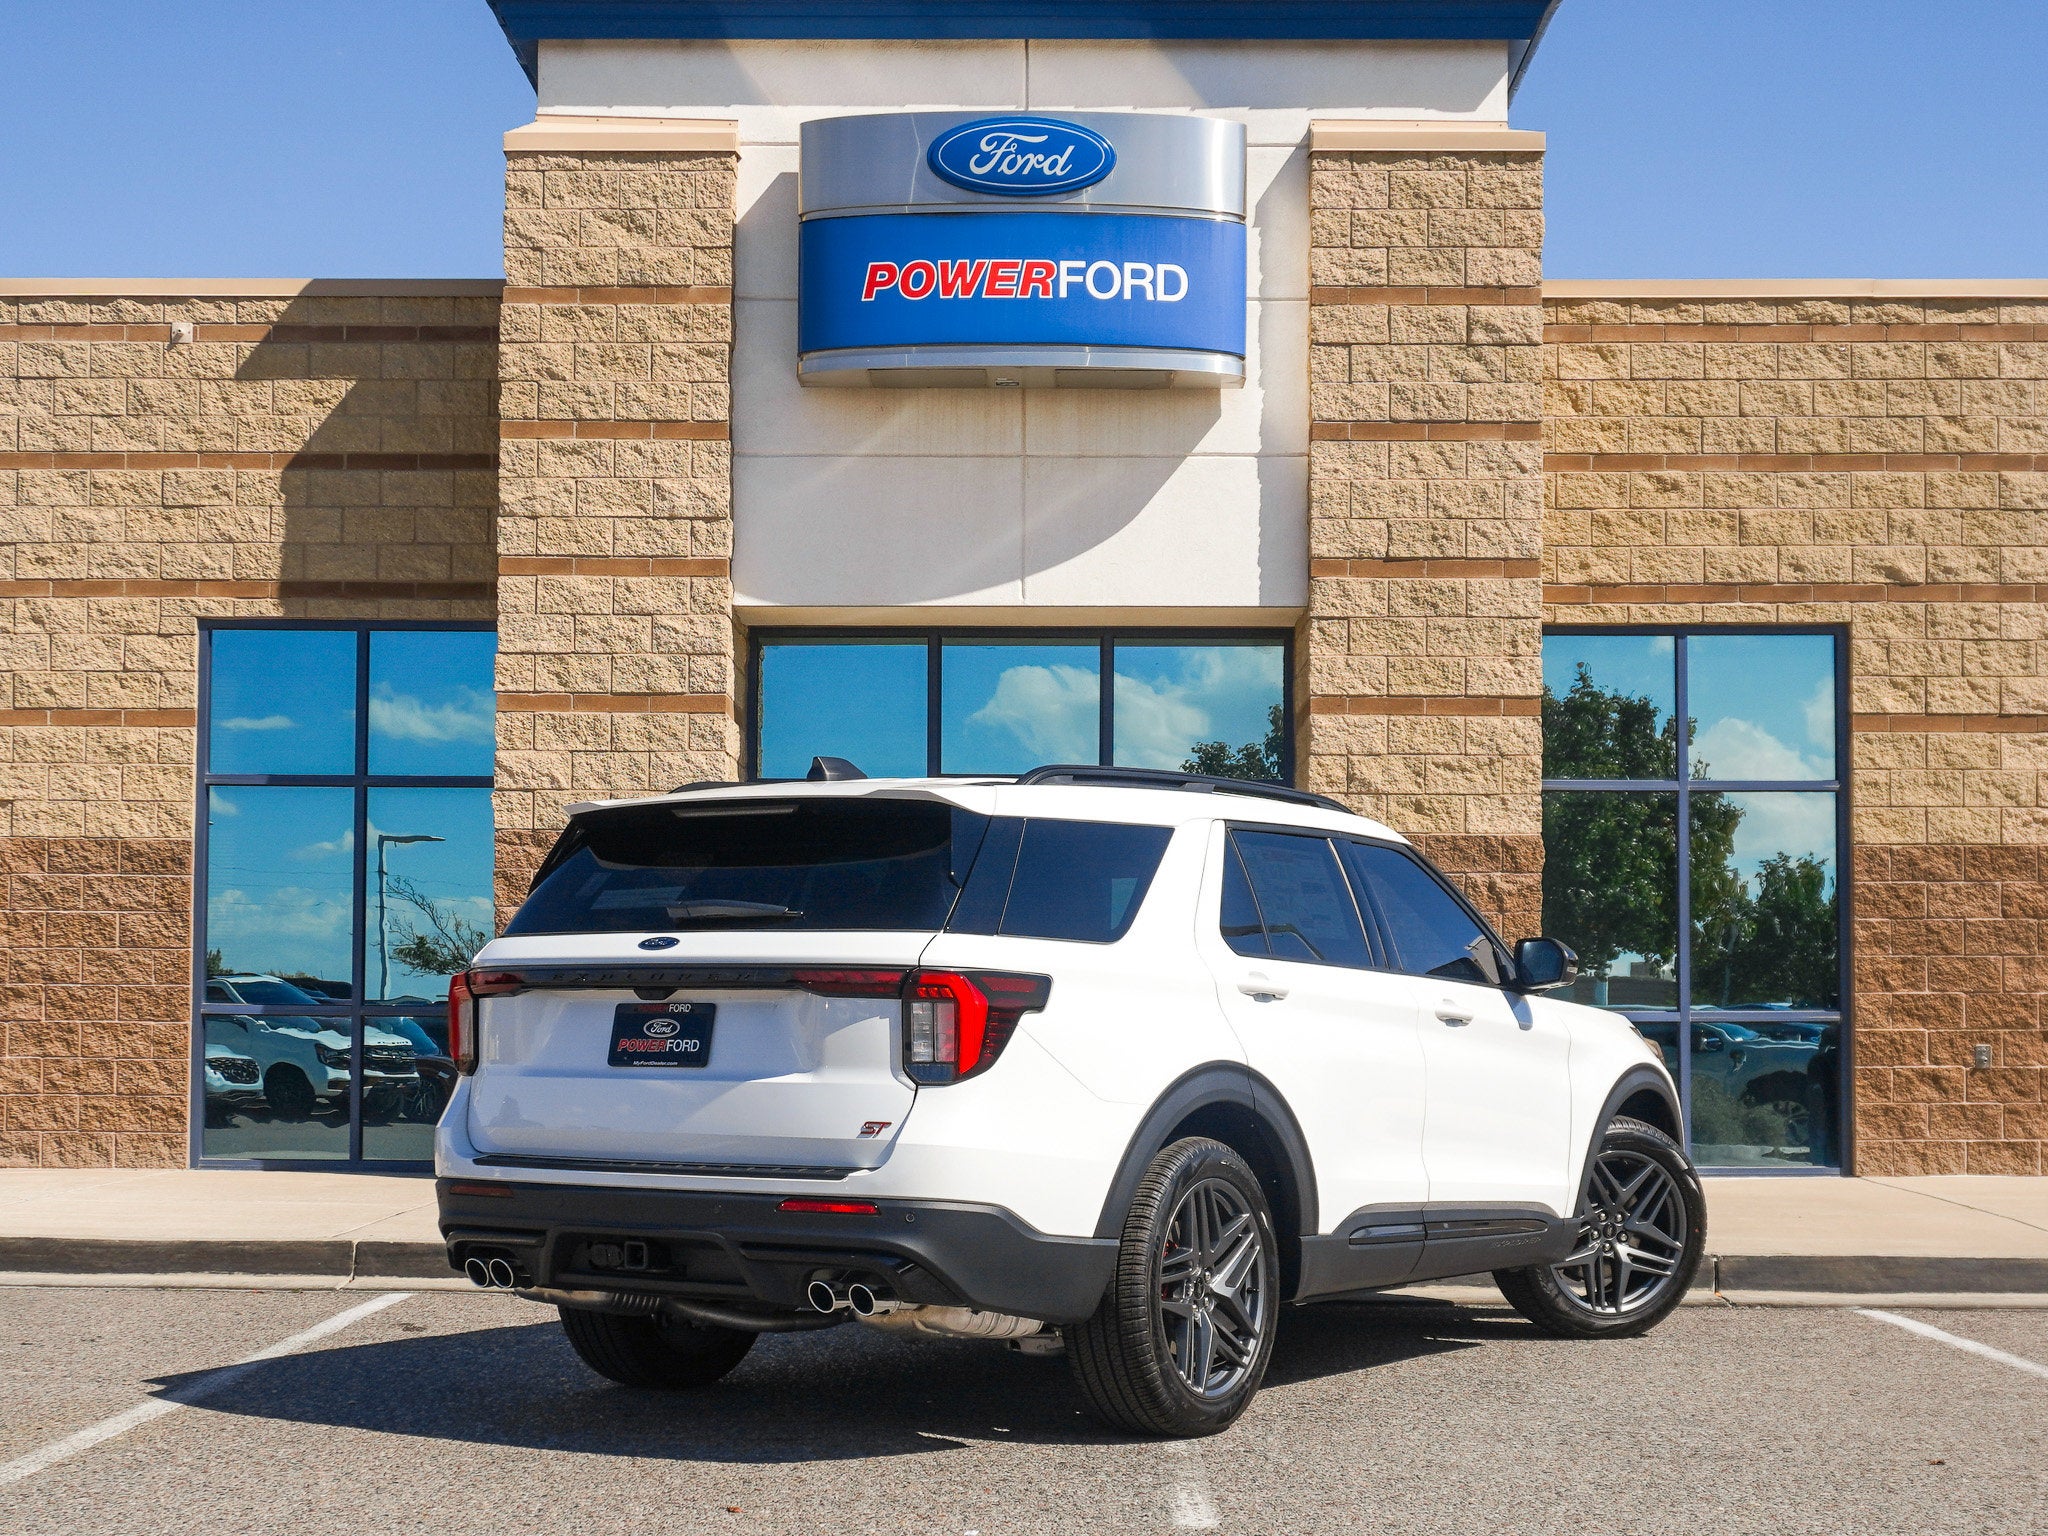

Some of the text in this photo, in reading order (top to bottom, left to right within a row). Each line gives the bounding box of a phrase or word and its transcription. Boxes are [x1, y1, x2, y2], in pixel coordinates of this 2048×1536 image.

[969, 132, 1076, 177] Ford
[861, 259, 1189, 302] POWERFORD
[650, 1021, 674, 1034] Ford
[617, 1038, 701, 1053] POWERFORD
[857, 1121, 892, 1138] ST
